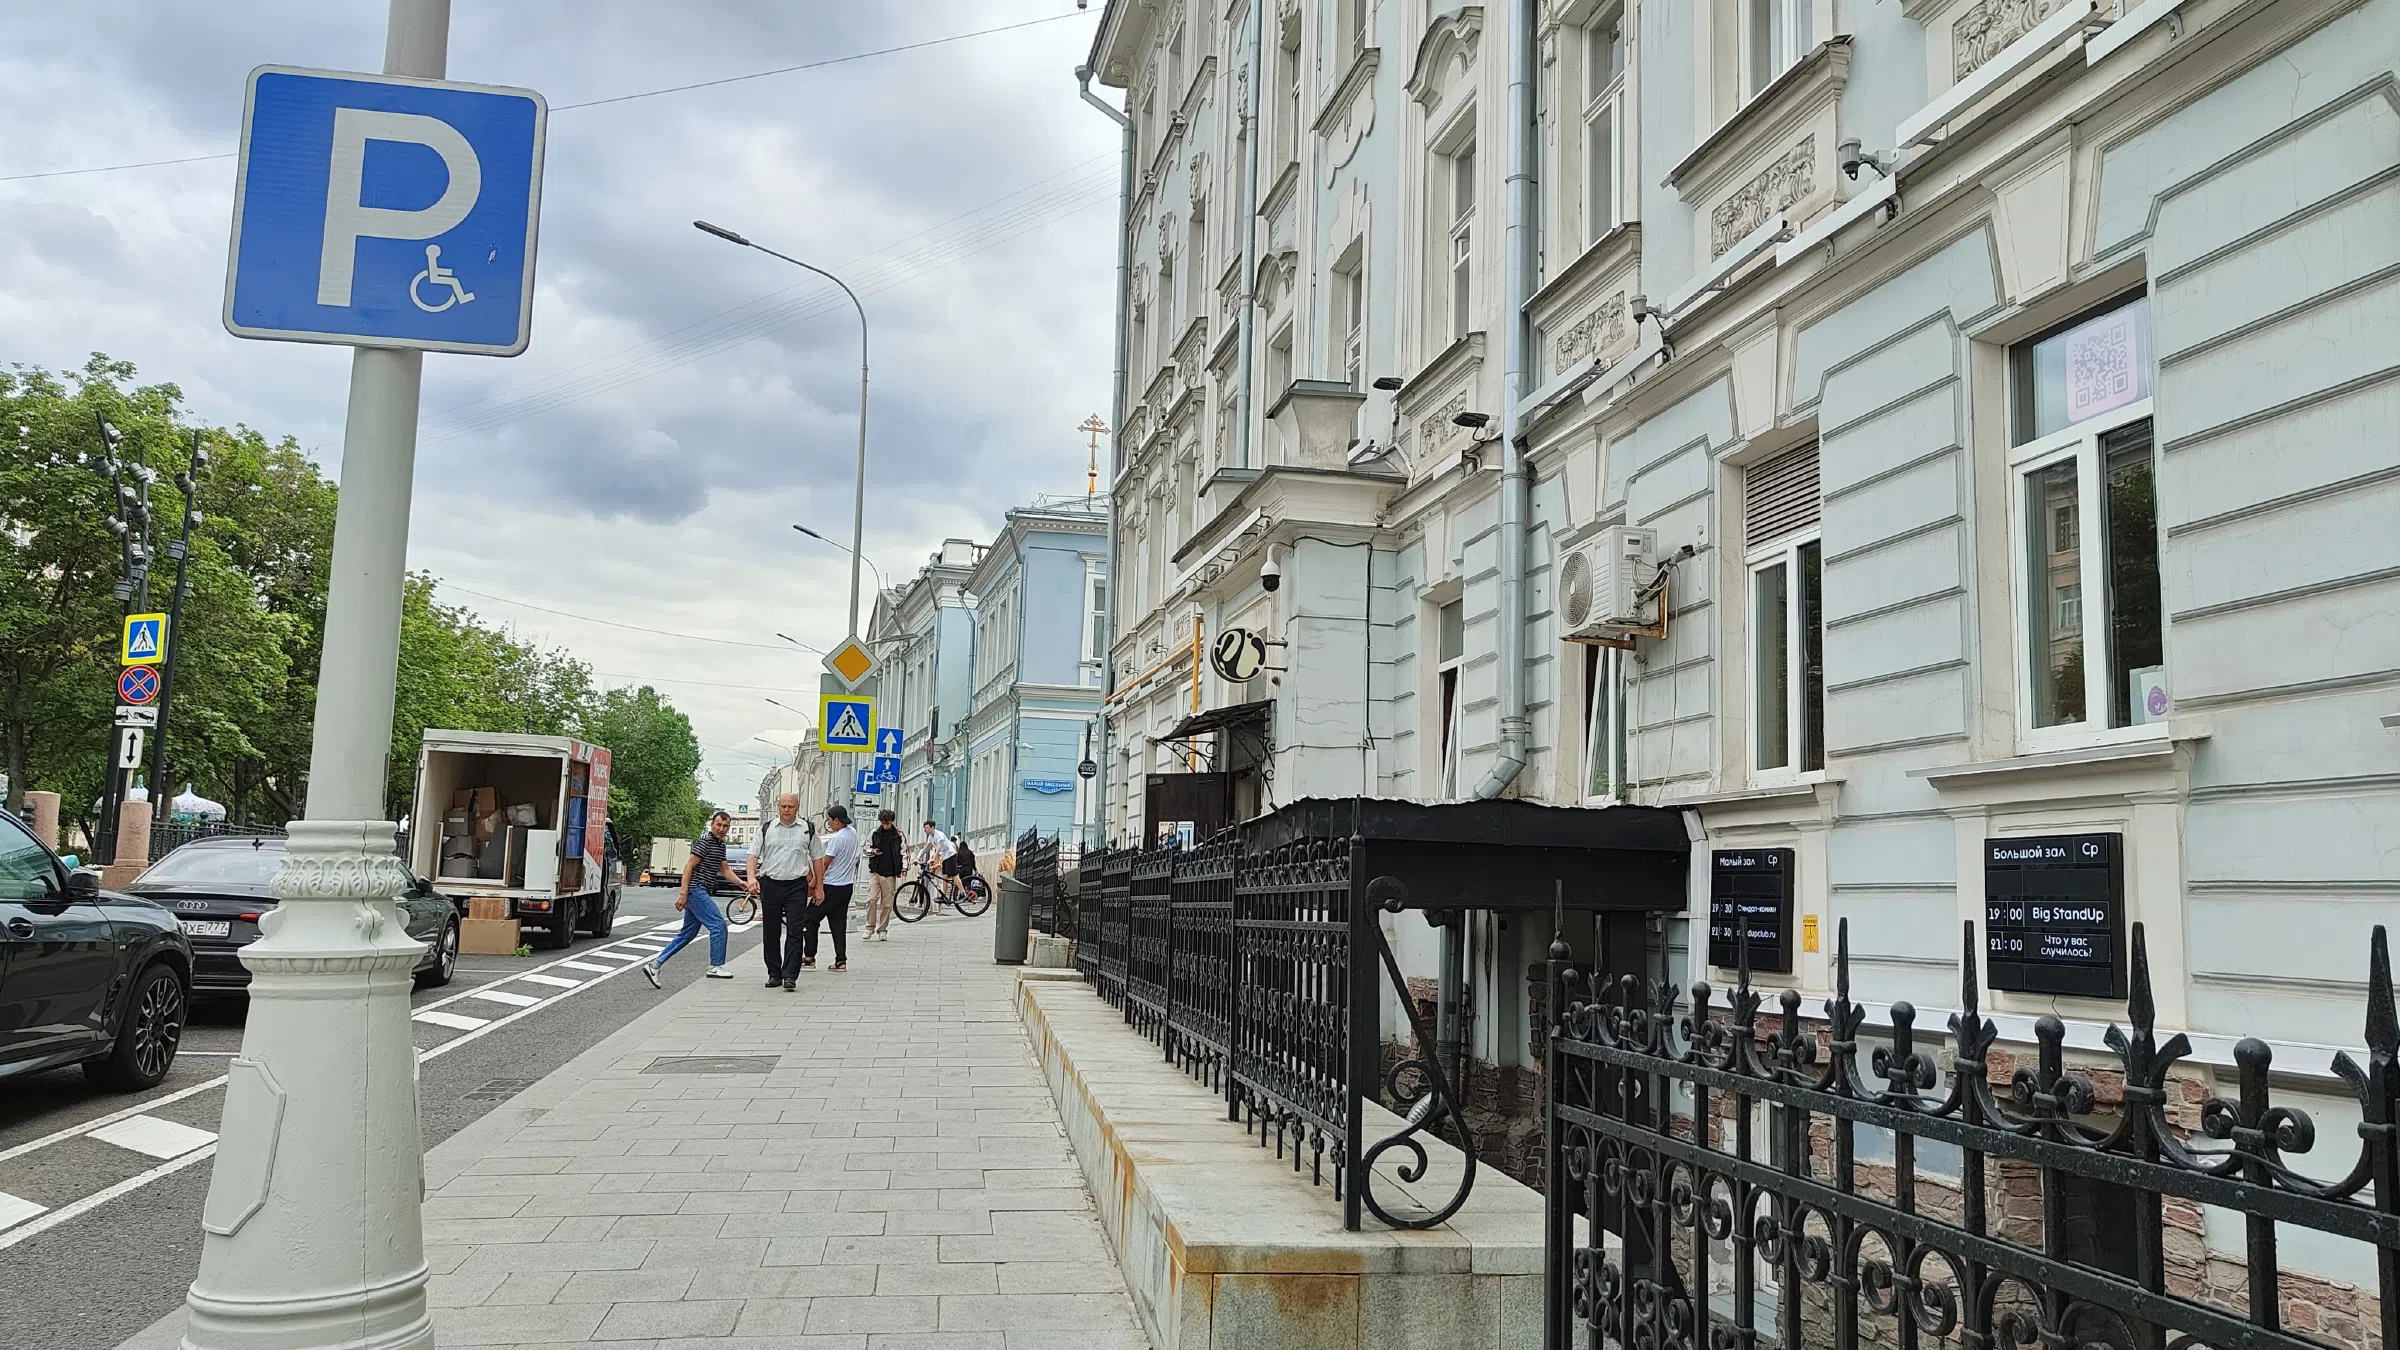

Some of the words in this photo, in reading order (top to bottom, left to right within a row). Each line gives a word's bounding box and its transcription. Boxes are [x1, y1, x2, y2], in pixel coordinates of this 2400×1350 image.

[316, 106, 482, 307] P
[1993, 845, 2043, 860] Большой
[2045, 848, 2066, 858] зал
[2082, 842, 2099, 858] Ср
[1719, 856, 1743, 867] Малый
[1743, 859, 1756, 867] зал
[1767, 855, 1778, 867] Ср
[2032, 907, 2051, 923] Big
[2052, 907, 2105, 924] StandUp
[207, 921, 227, 931] 777
[1736, 928, 1777, 939] sdupclub.ru
[2044, 935, 2062, 946] Что
[2063, 937, 2070, 948] у
[2071, 937, 2088, 946] вас
[2040, 946, 2093, 958] случилось?
